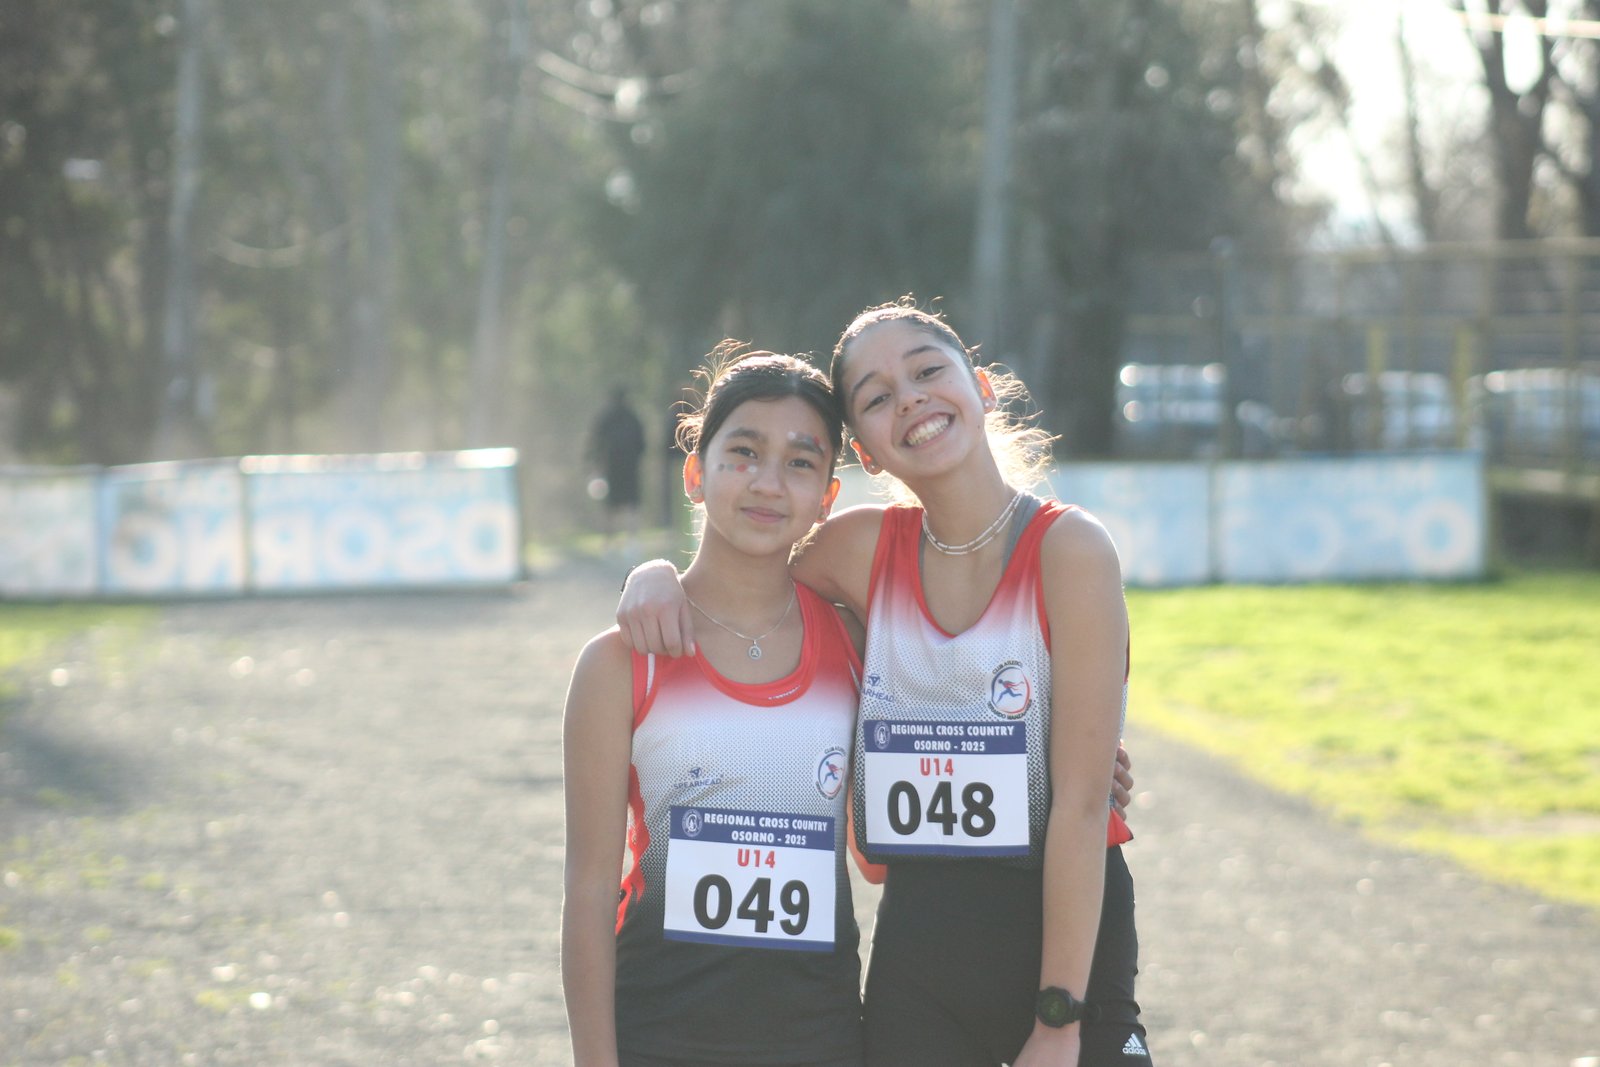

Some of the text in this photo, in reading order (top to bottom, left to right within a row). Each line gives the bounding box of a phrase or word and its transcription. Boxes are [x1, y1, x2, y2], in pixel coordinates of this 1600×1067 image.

[891, 724, 934, 736] REGIONAL
[936, 725, 964, 736] CROSS
[967, 725, 1015, 737] COUNTRY
[914, 740, 951, 751] OSORNO
[960, 741, 985, 751] 2025
[920, 757, 954, 776] U14
[674, 778, 722, 789] SPEARHEAD
[887, 780, 996, 837] 048
[703, 812, 756, 827] REGIONAL
[759, 816, 789, 829] CROSS
[792, 819, 828, 832] COUNTRY
[731, 830, 775, 844] OSORNO
[785, 834, 807, 845] 2025
[737, 848, 776, 868] U14
[693, 874, 810, 936] 049
[1122, 1046, 1147, 1056] adidas
